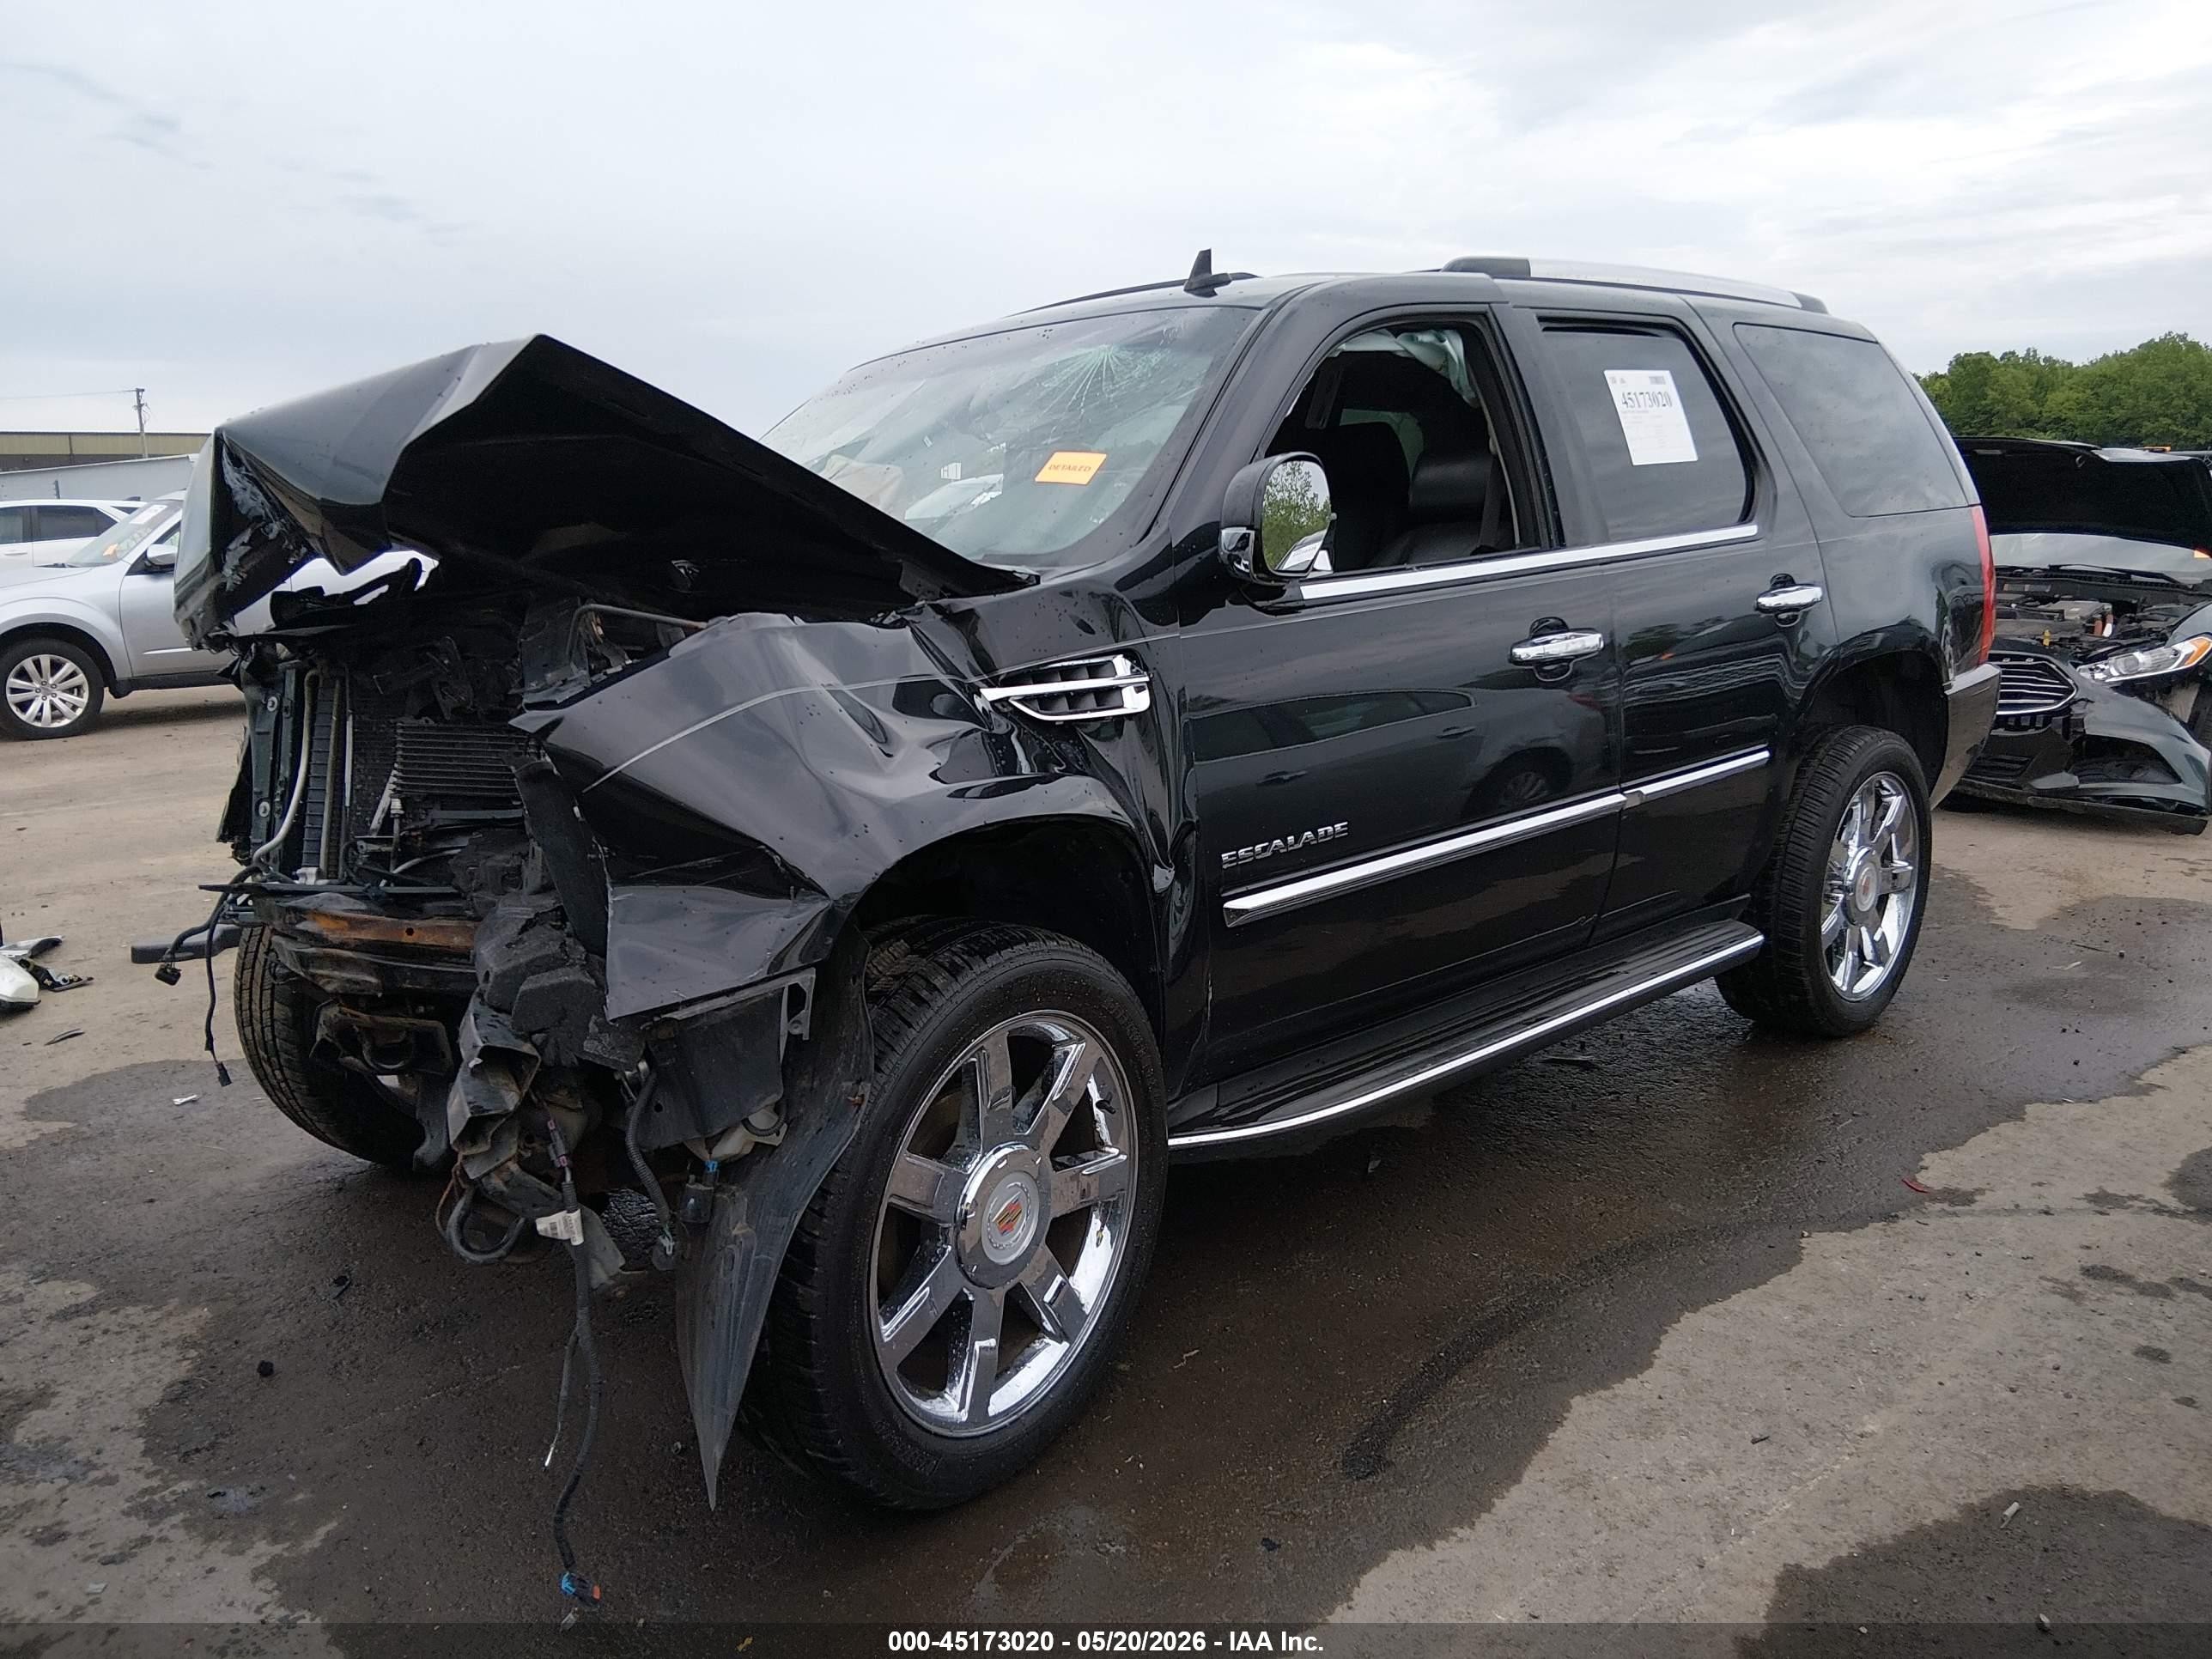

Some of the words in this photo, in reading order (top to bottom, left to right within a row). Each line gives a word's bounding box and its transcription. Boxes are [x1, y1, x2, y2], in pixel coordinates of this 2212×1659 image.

[1621, 392, 1673, 408] 45173020
[1048, 464, 1092, 472] DETAILED
[1221, 822, 1348, 869] ESCALADE
